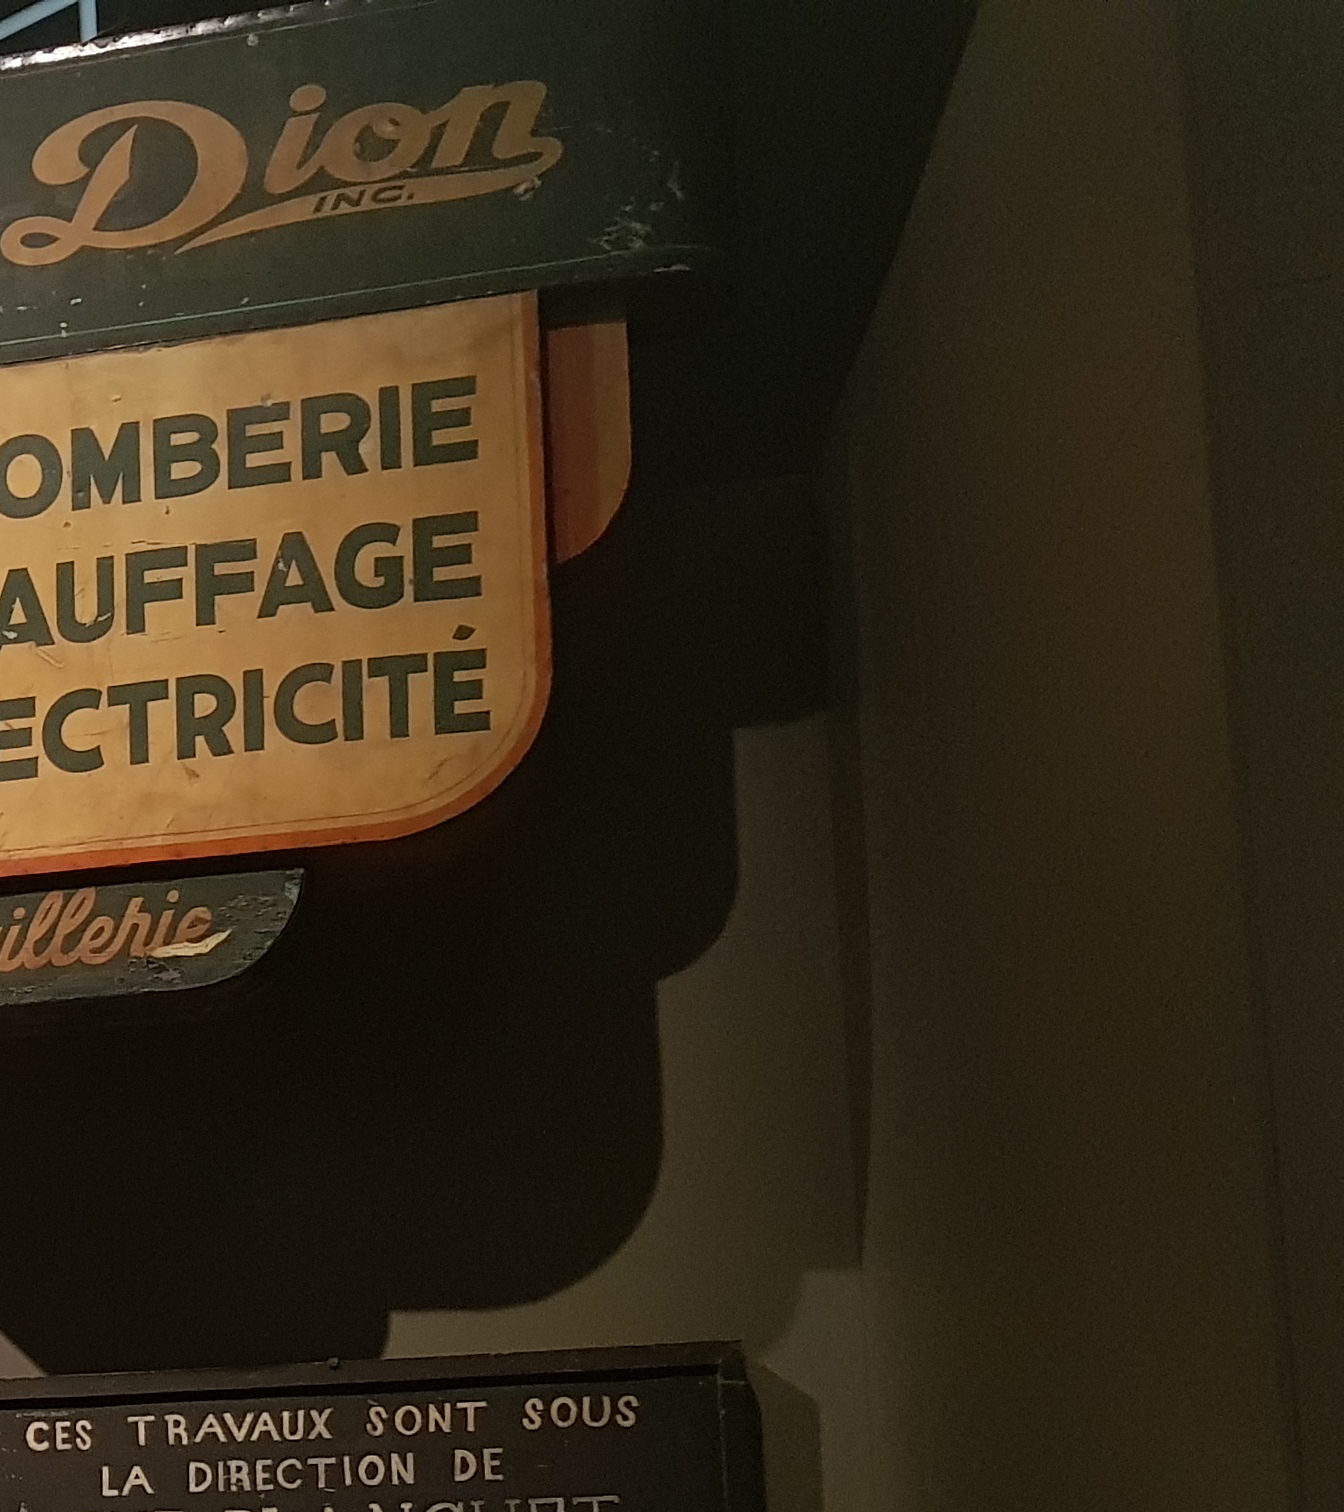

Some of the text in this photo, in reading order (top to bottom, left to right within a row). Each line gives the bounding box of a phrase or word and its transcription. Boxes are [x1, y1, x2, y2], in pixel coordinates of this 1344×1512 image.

[0, 79, 563, 267] Dion
[25, 1393, 642, 1454] CES TRAVAUX SONT SOUS
[100, 1447, 506, 1499] LA DIRECTION DE
